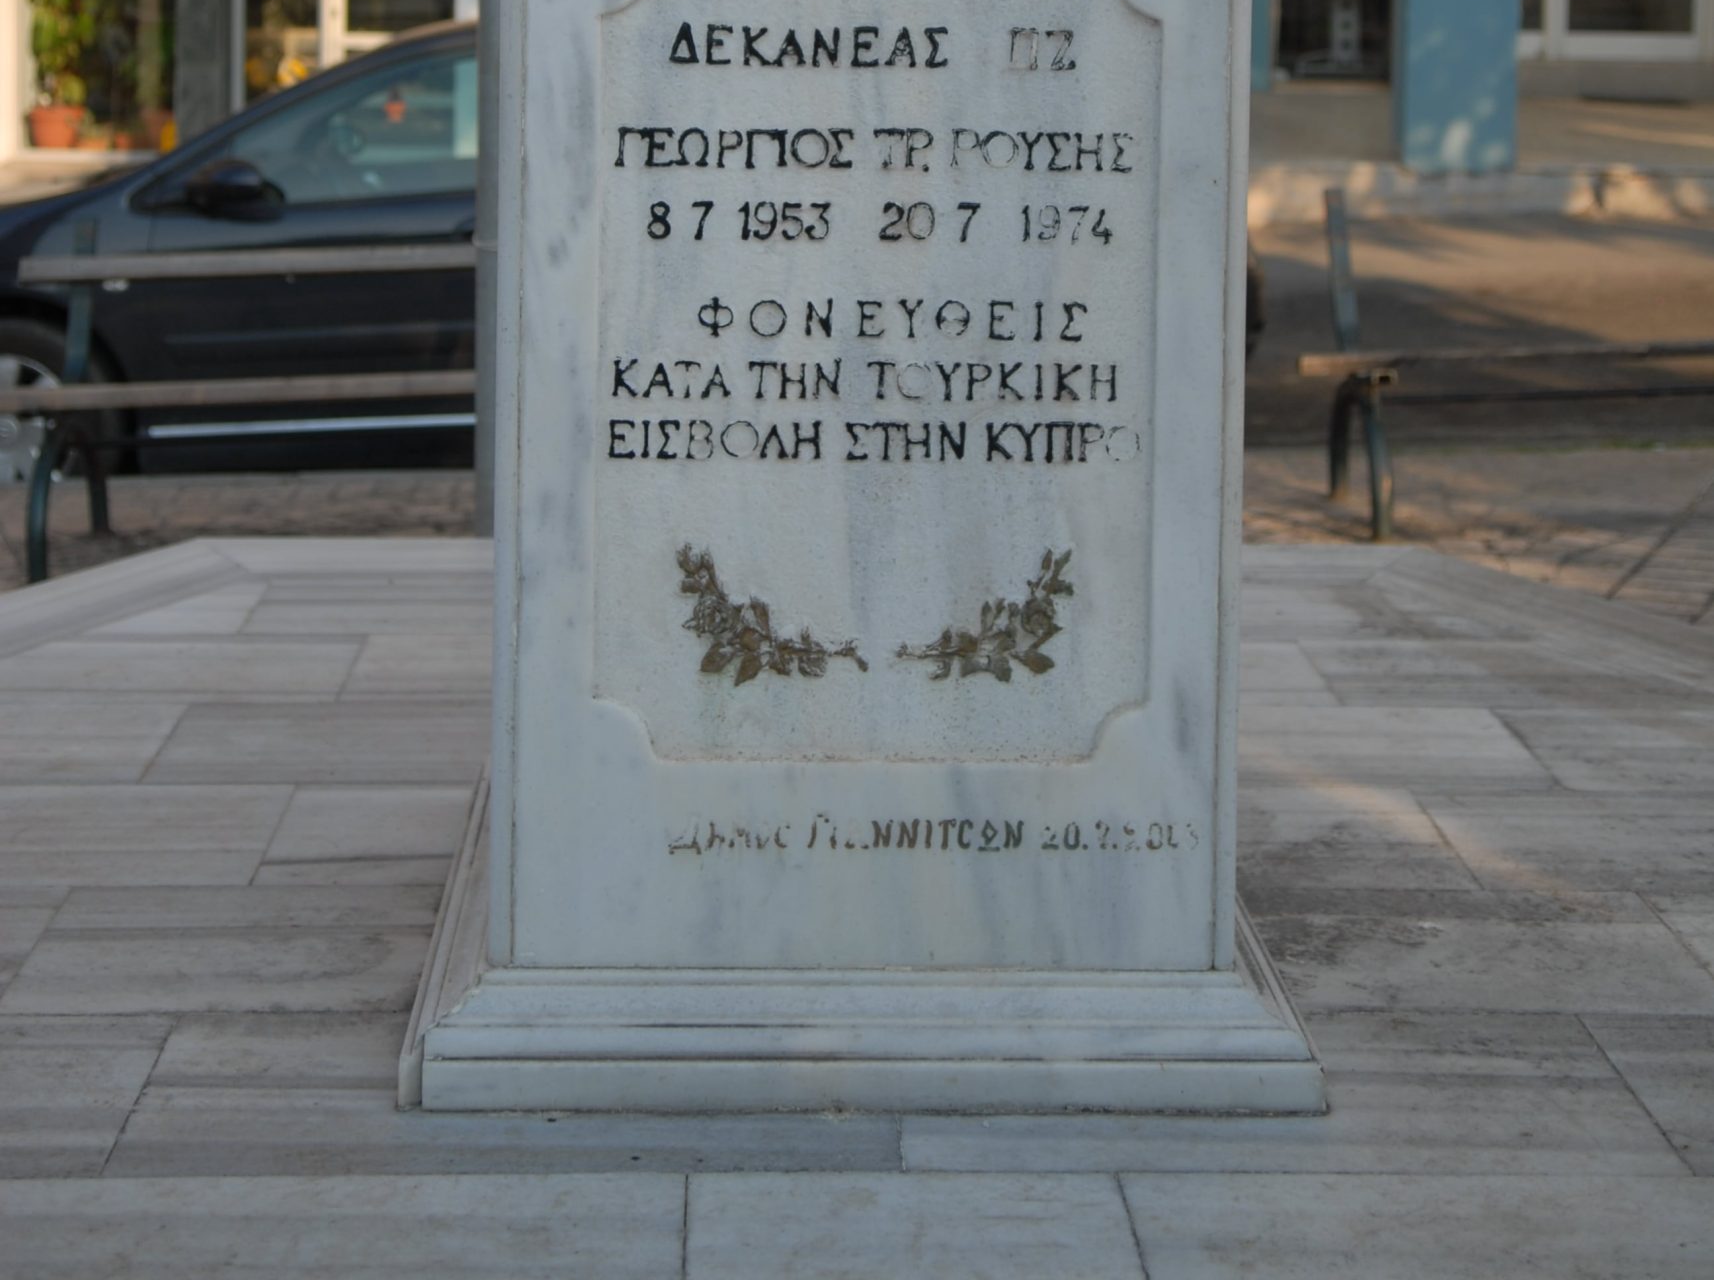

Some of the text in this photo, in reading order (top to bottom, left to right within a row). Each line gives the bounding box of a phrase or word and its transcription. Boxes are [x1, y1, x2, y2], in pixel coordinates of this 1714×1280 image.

[668, 21, 949, 69] ΔΕΚΑΝΕΑΣ
[873, 127, 931, 173] ΤΡ.
[950, 128, 1134, 174] ΡΟΥΣΗΣ
[646, 200, 1114, 246] 8 7 1953 20 7 1974
[697, 296, 1088, 343] ΦΟΝΕΥΘΕΙΣ
[611, 356, 1117, 403] ΚΑΤΑ ΤΗΝ ΤΟΥΡΚΙΚΗ
[607, 419, 1141, 465] ΕΙΣΒΟΛΗ ΣΤΗΝ ΚΥΠΡΟ
